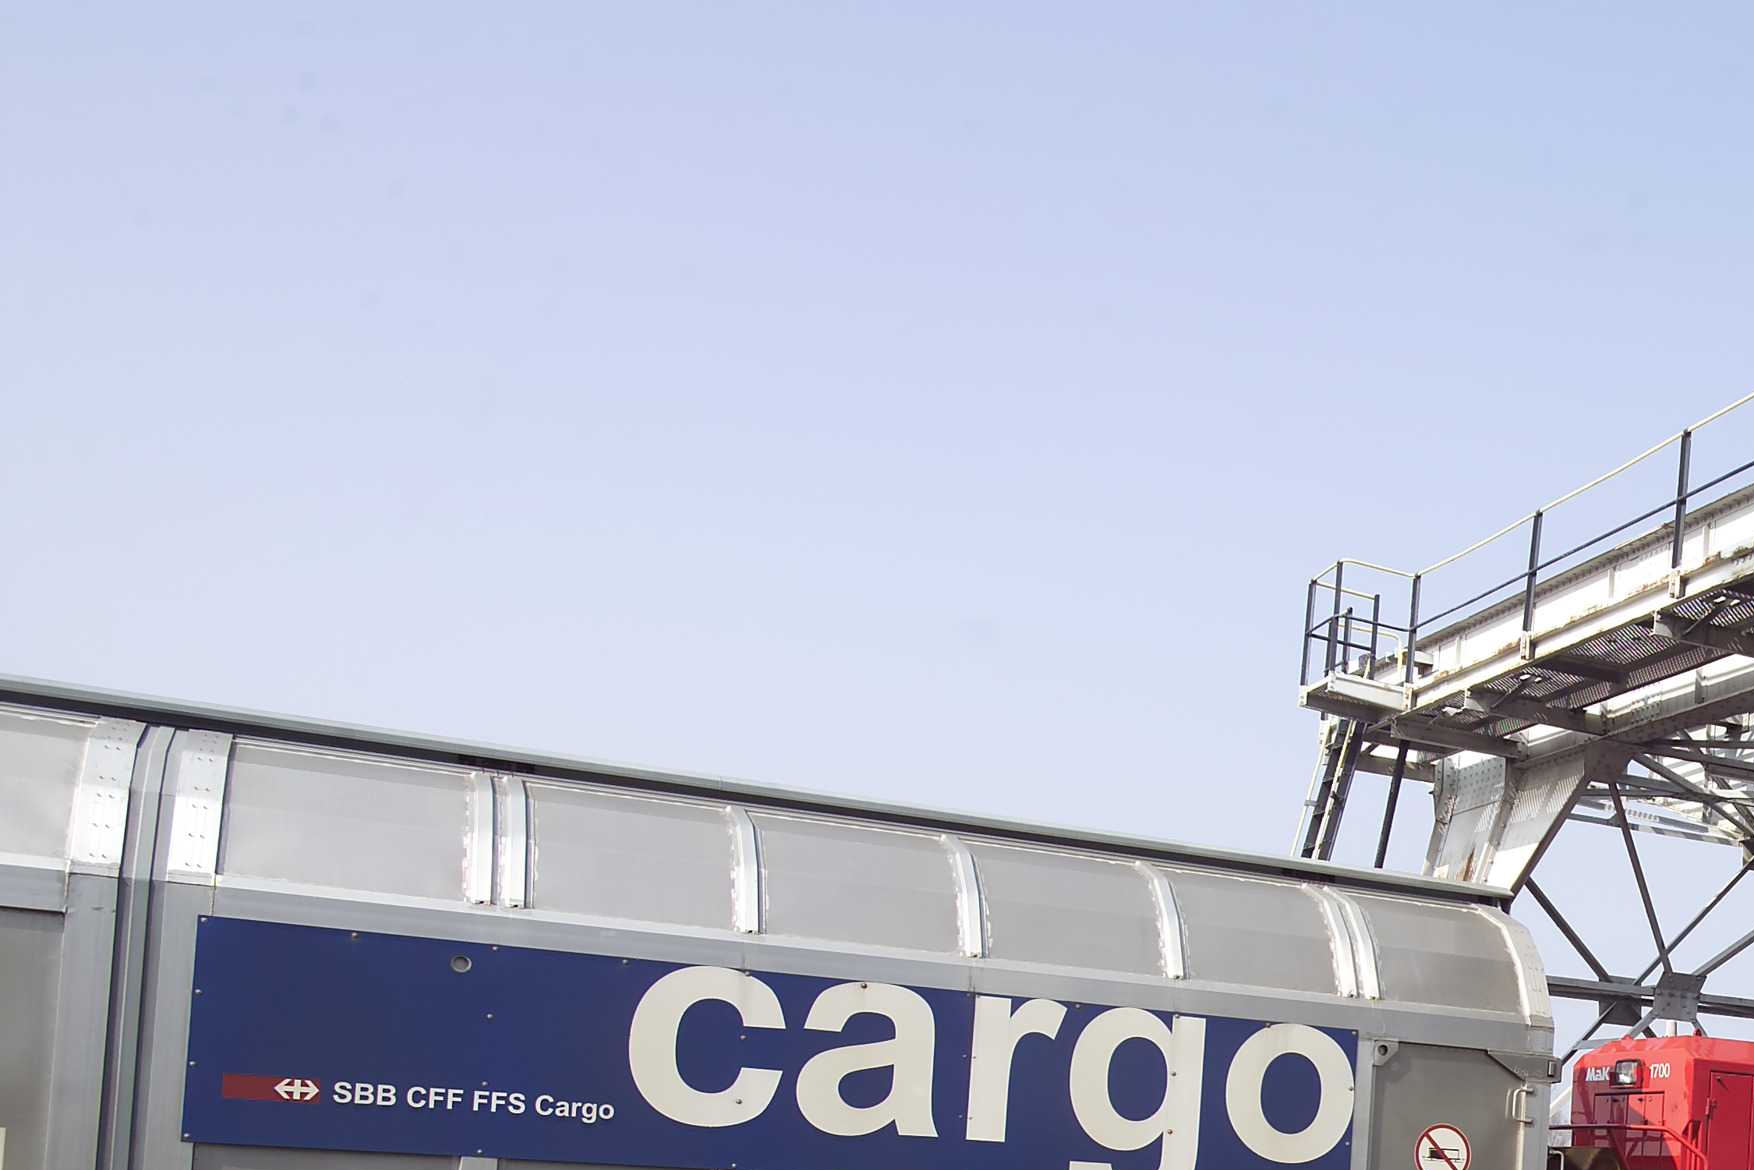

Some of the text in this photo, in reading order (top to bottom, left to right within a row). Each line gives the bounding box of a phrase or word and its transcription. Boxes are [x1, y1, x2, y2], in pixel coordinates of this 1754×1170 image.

[1585, 1062, 1671, 1081] MaK 1700
[332, 1080, 615, 1124] SBB CFF FFS Cargo
